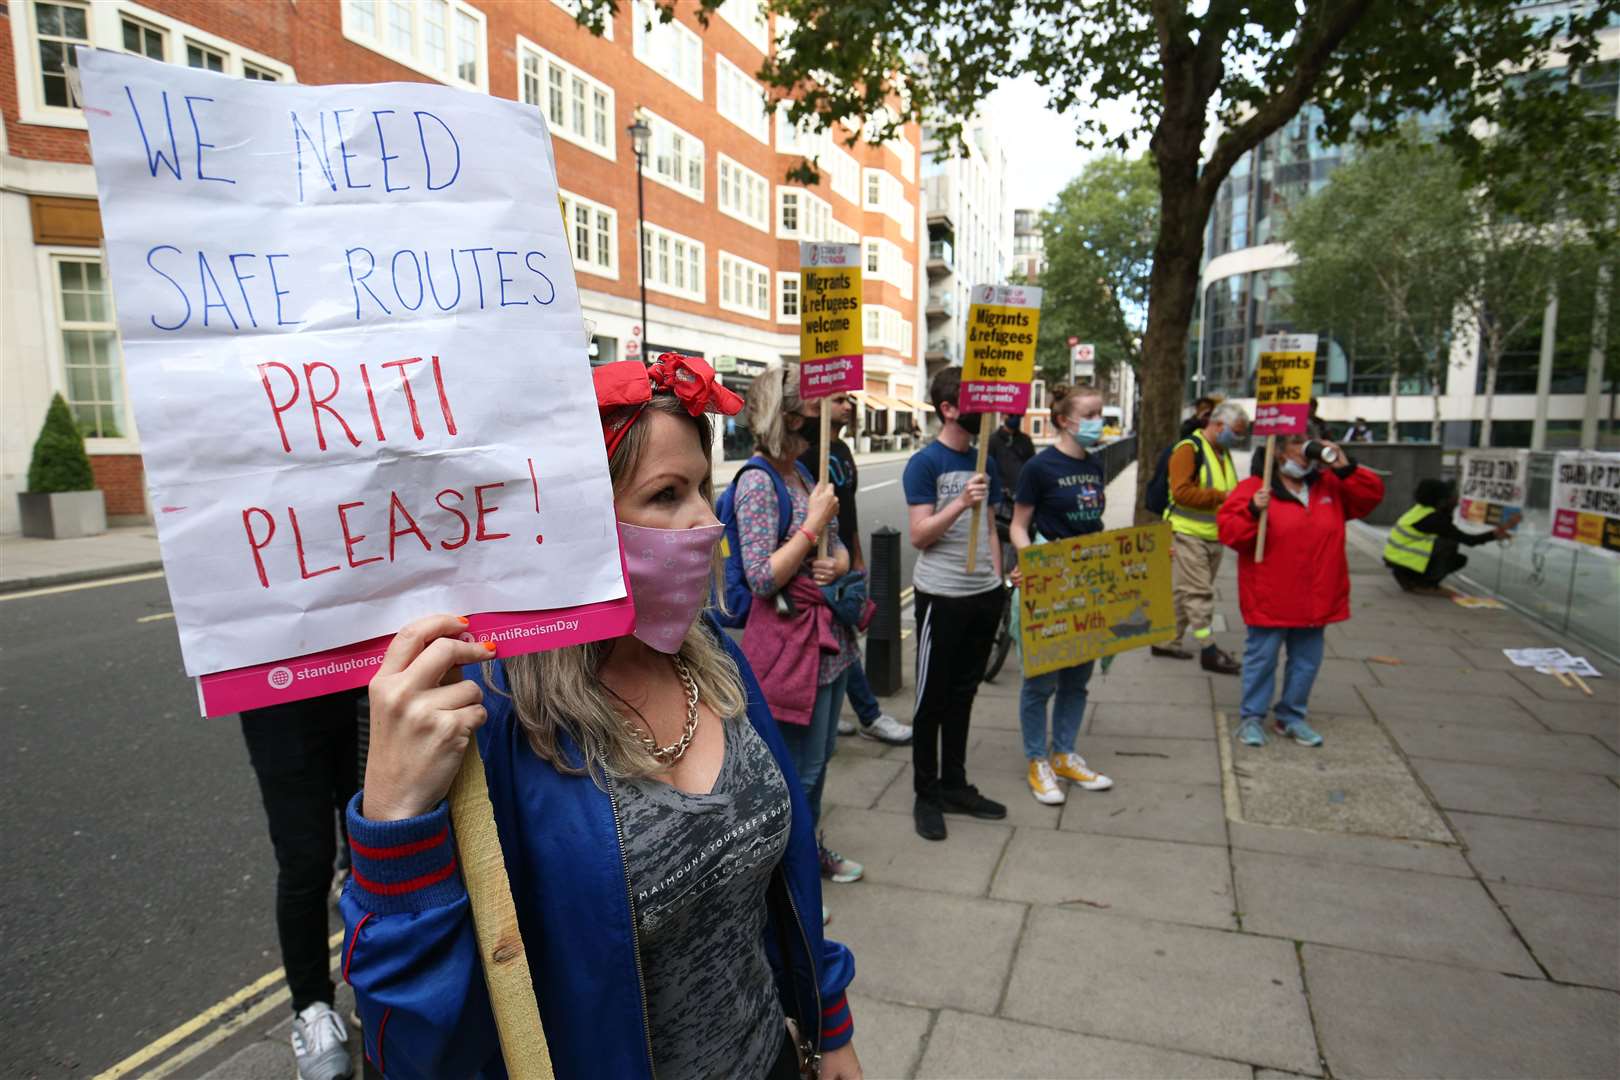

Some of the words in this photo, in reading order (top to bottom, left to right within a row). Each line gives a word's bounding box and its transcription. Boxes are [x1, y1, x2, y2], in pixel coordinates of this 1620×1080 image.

[124, 85, 237, 185] WE
[290, 108, 461, 202] NEED
[146, 244, 307, 331] SAFE
[345, 246, 556, 320] ROUTES
[806, 272, 851, 295] Migrants
[809, 294, 858, 316] refugees
[806, 315, 850, 335] welcome
[976, 308, 1030, 328] Migrants
[815, 337, 840, 355] here
[978, 327, 1034, 346] refugees
[973, 345, 1024, 362] welcome
[979, 362, 1007, 378] here
[257, 356, 458, 454] PRITI
[242, 458, 544, 589] PLEASE!
[1114, 535, 1133, 555] To
[478, 618, 580, 645] @AntiRacismDay
[296, 654, 384, 680] standuptorac
[639, 852, 706, 900] MAIMOUNA
[710, 818, 758, 852] YOUSSEF
